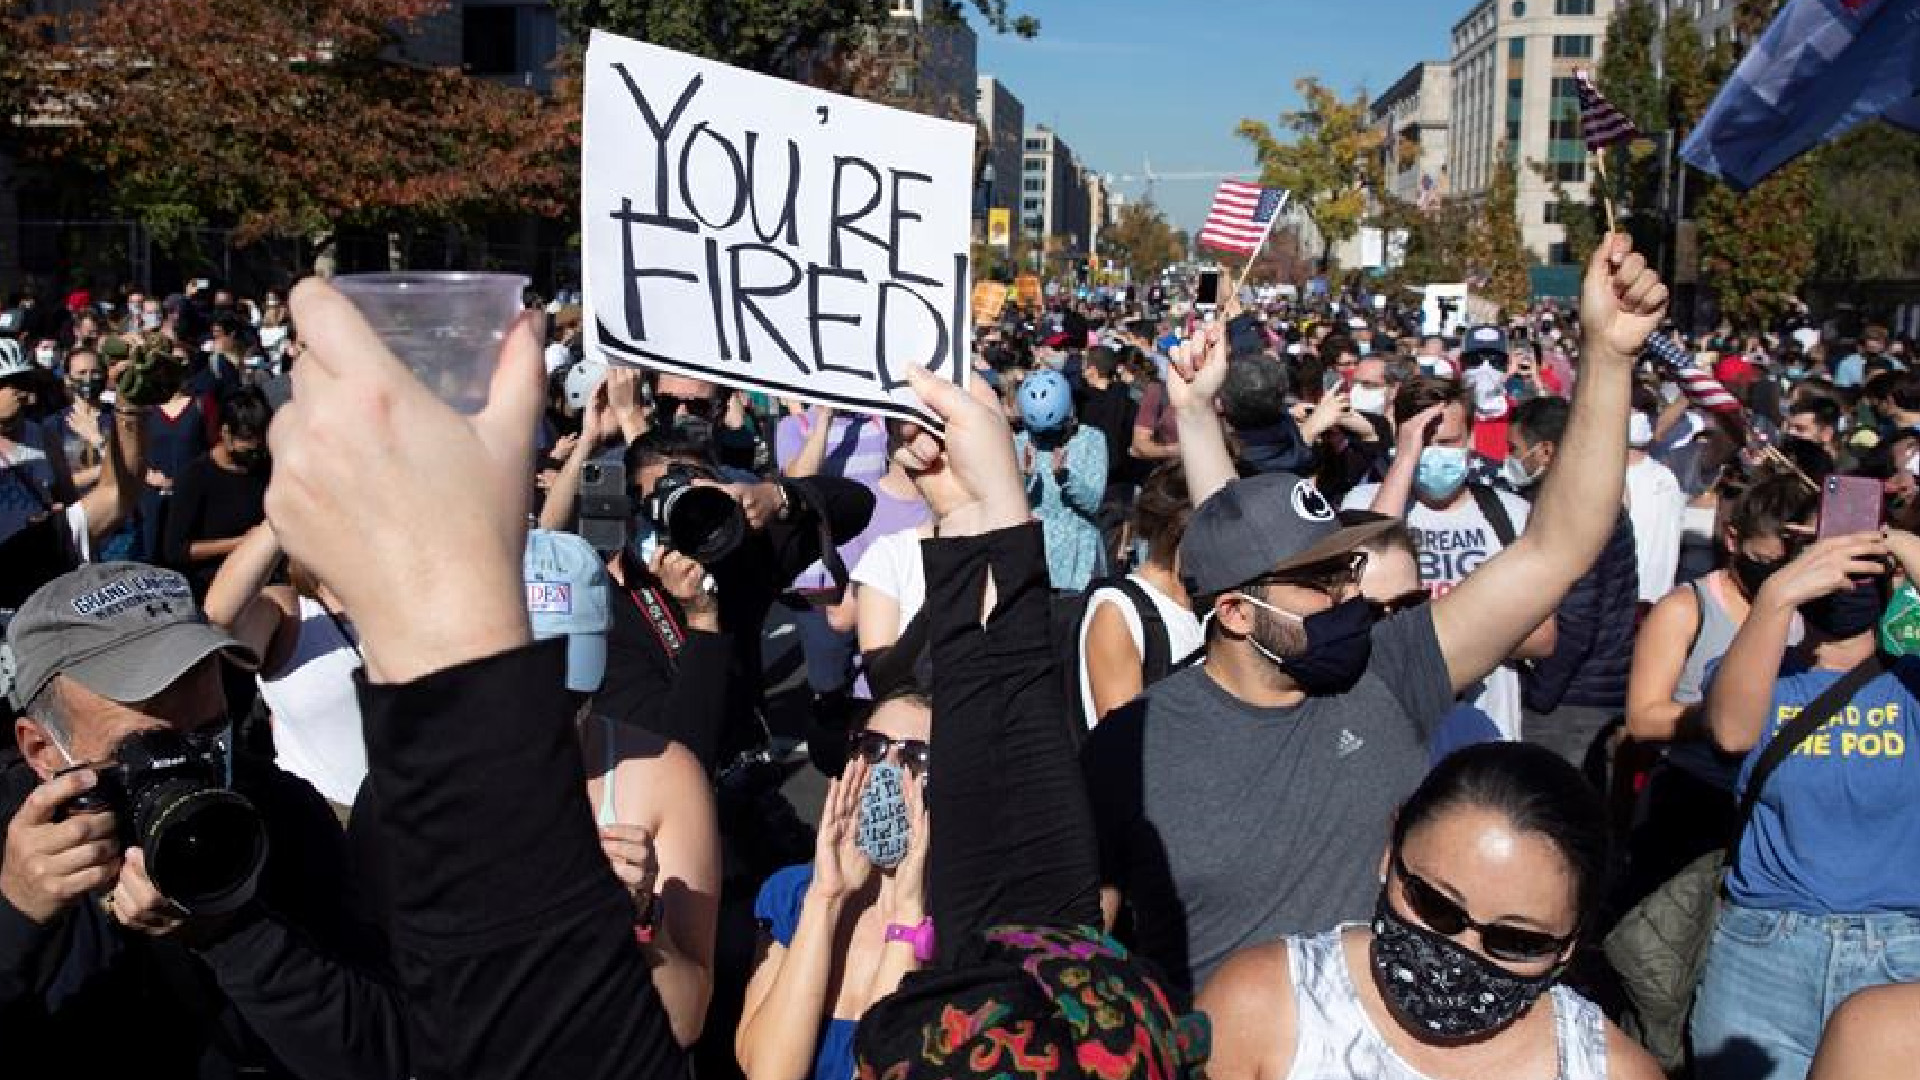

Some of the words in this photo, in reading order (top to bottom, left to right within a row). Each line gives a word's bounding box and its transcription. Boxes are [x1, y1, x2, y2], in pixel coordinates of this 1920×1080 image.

[610, 62, 944, 288] YOU'RE
[1867, 702, 1899, 728] OF
[1842, 731, 1905, 757] POD
